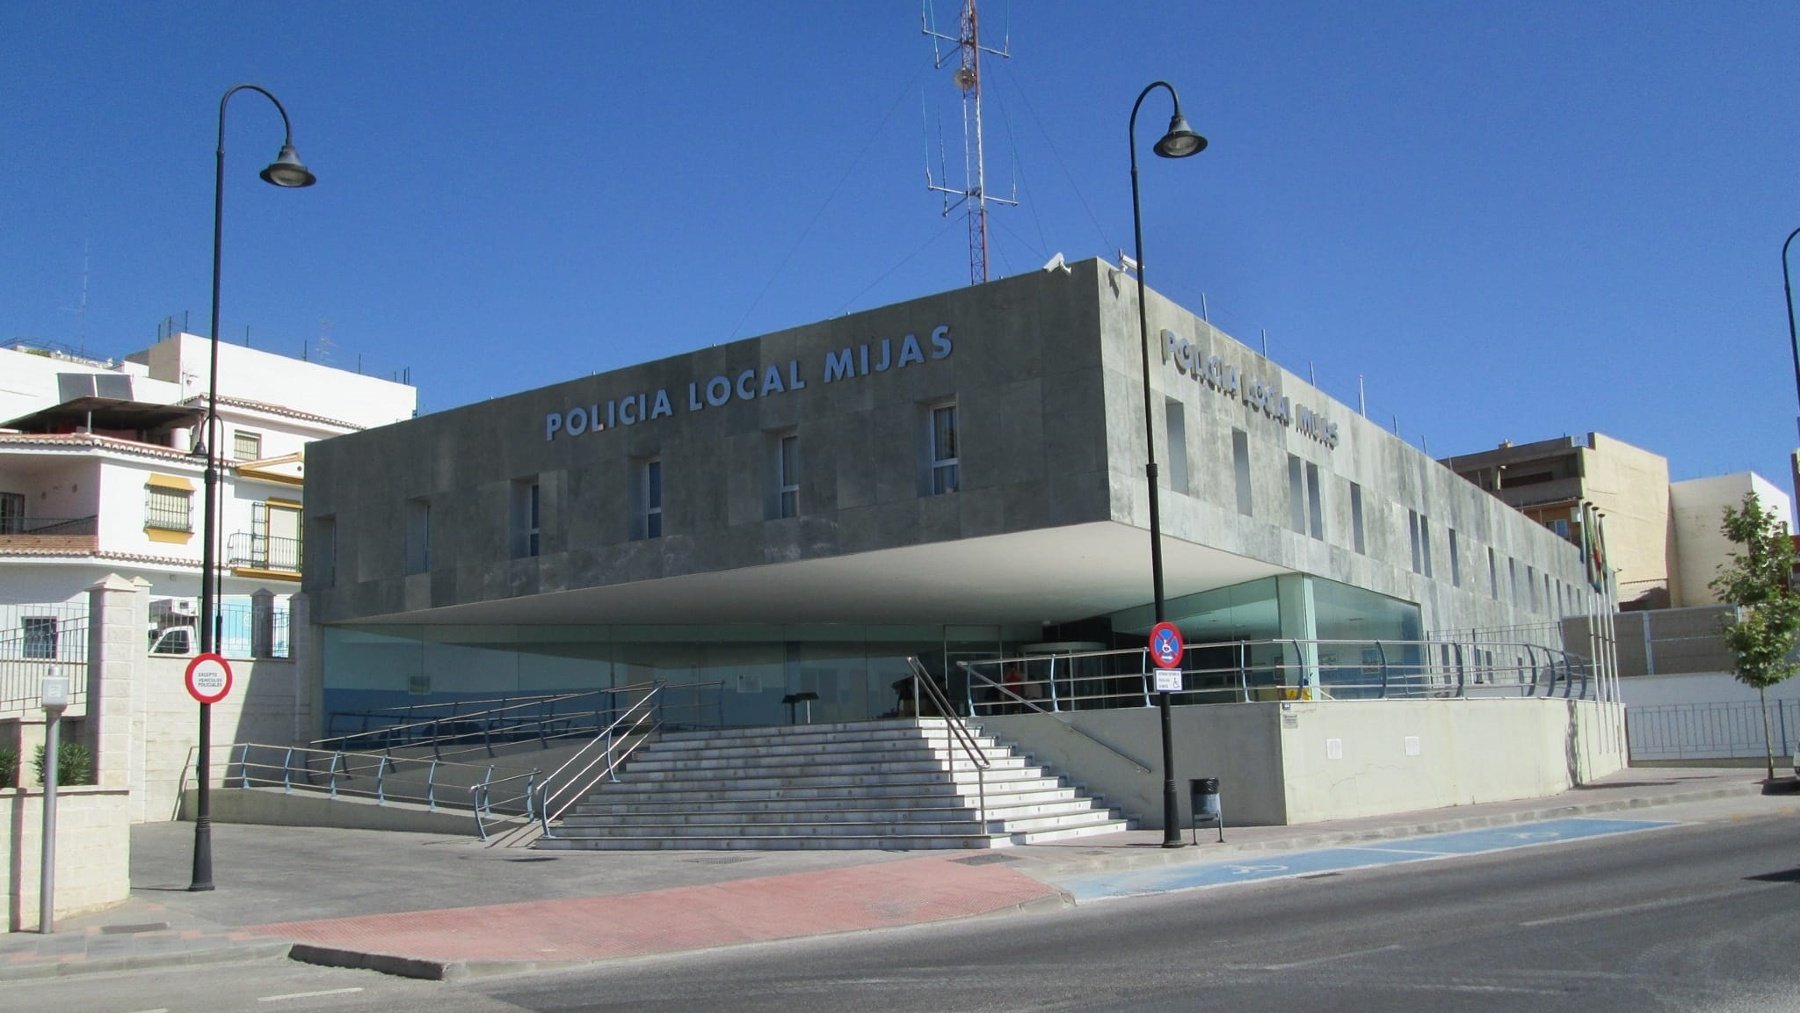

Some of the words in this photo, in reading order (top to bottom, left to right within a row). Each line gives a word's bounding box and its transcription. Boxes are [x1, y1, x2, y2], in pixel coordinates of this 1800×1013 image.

[546, 388, 673, 441] POLICIA
[689, 359, 807, 412] LOCAL
[823, 324, 953, 384] MIJAS
